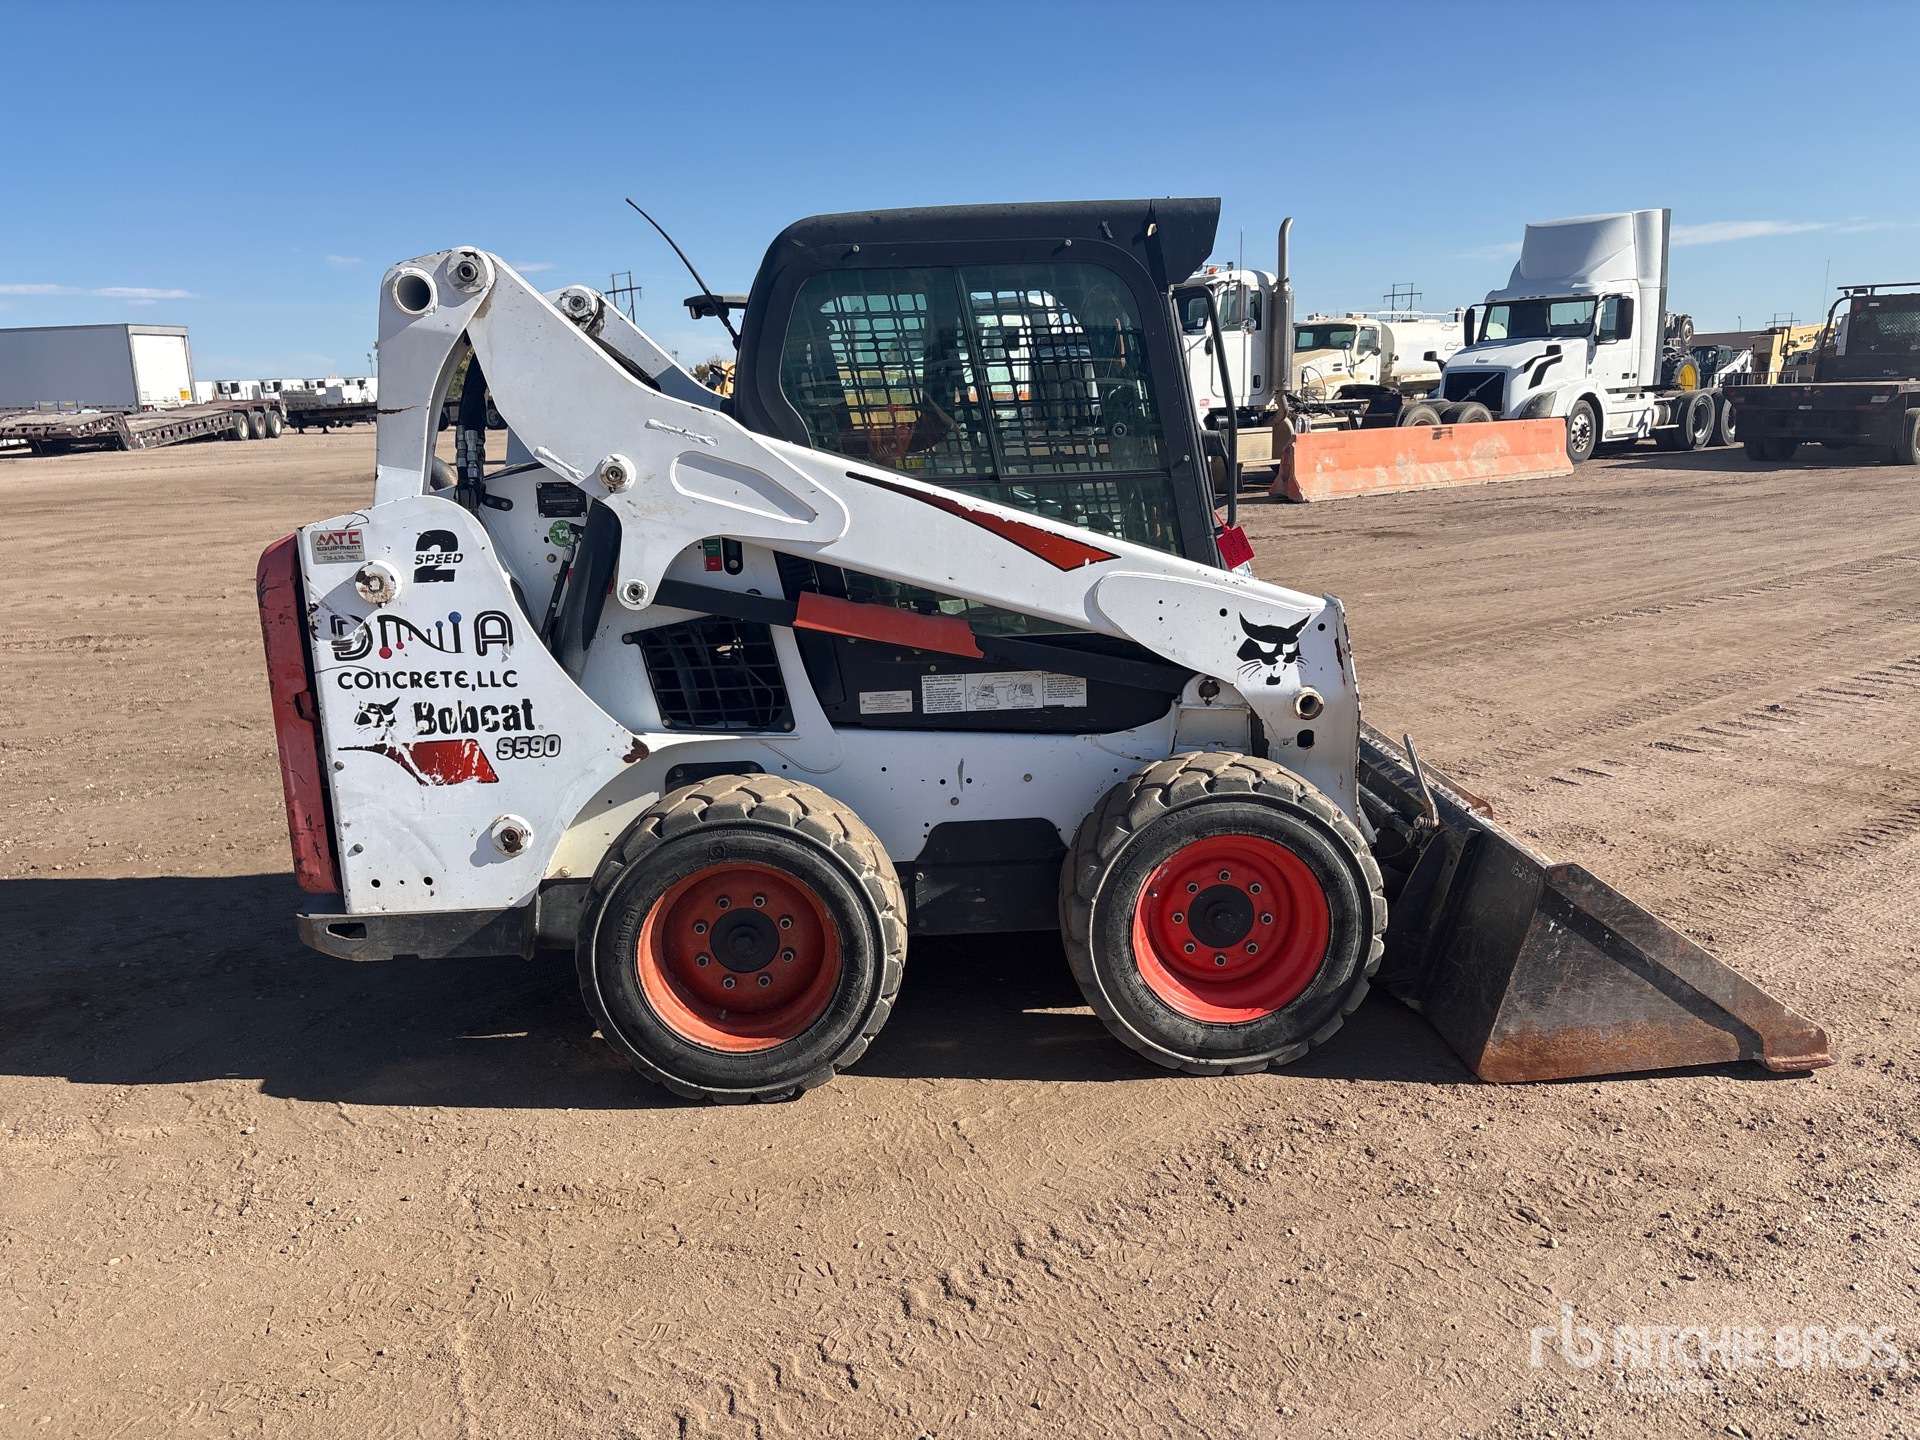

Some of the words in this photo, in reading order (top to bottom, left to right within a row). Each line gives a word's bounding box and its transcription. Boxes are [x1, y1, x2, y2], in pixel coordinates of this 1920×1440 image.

[316, 531, 361, 546] MTC
[556, 529, 570, 539] T4
[413, 529, 459, 583] 2
[414, 553, 464, 565] SPEED
[413, 698, 536, 736] Bobcat
[496, 734, 562, 760] S590
